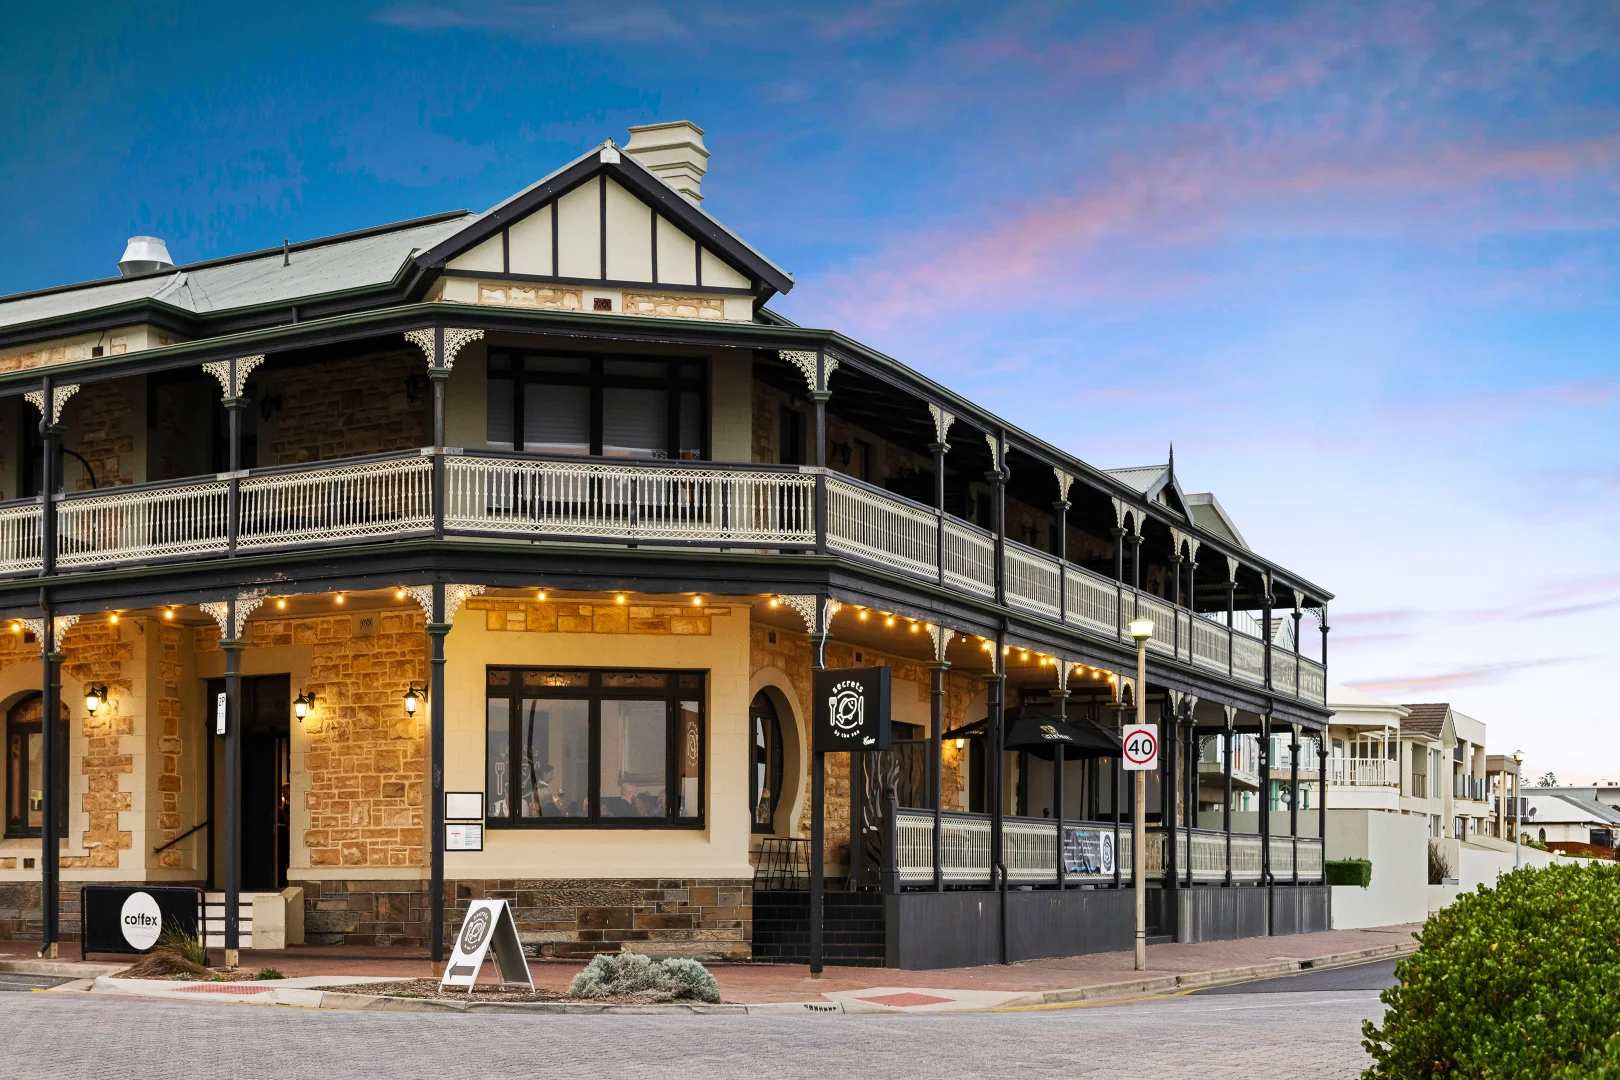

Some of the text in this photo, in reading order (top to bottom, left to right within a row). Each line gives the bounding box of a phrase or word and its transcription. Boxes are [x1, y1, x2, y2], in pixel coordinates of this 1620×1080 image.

[832, 680, 864, 694] secrets
[218, 696, 226, 706] 2P
[833, 729, 840, 737] by
[1127, 739, 1153, 755] 40
[124, 912, 158, 926] coffex
